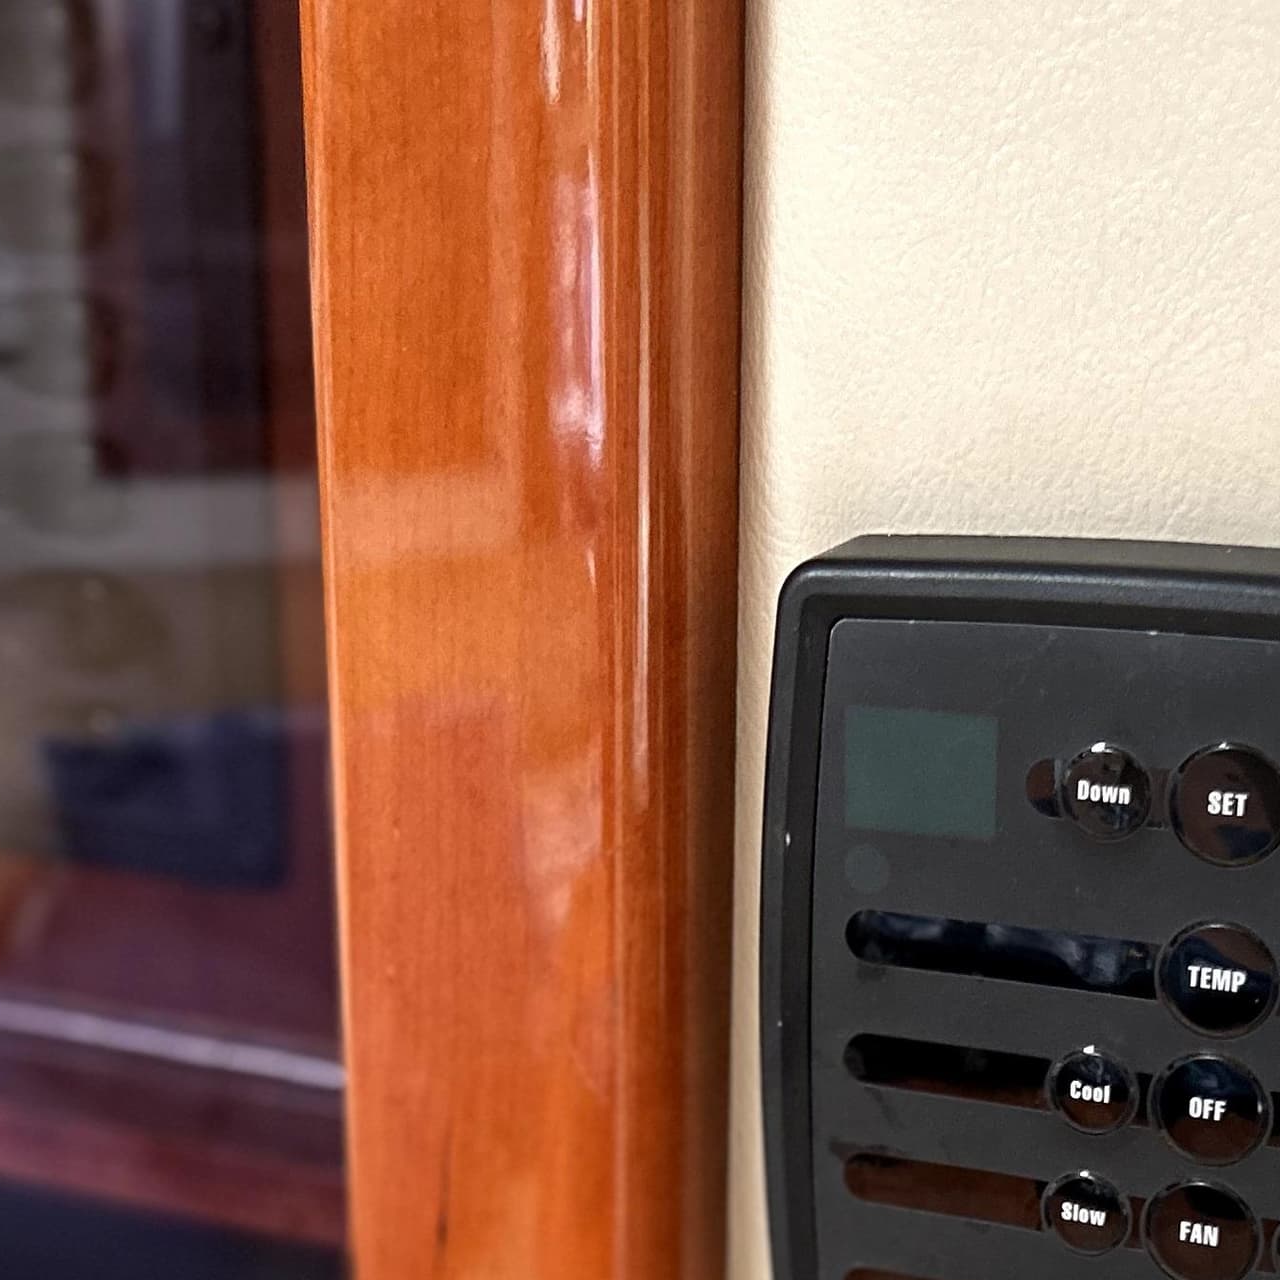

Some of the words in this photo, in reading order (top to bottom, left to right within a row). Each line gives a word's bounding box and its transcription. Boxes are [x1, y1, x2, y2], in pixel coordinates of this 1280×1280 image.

[1078, 780, 1130, 804] Down
[1208, 791, 1247, 816] SET
[1188, 966, 1246, 992] TEMP
[1070, 1081, 1110, 1103] Cool
[1189, 1097, 1226, 1120] OFF
[1061, 1202, 1105, 1226] Slow
[1180, 1221, 1218, 1246] FAN
